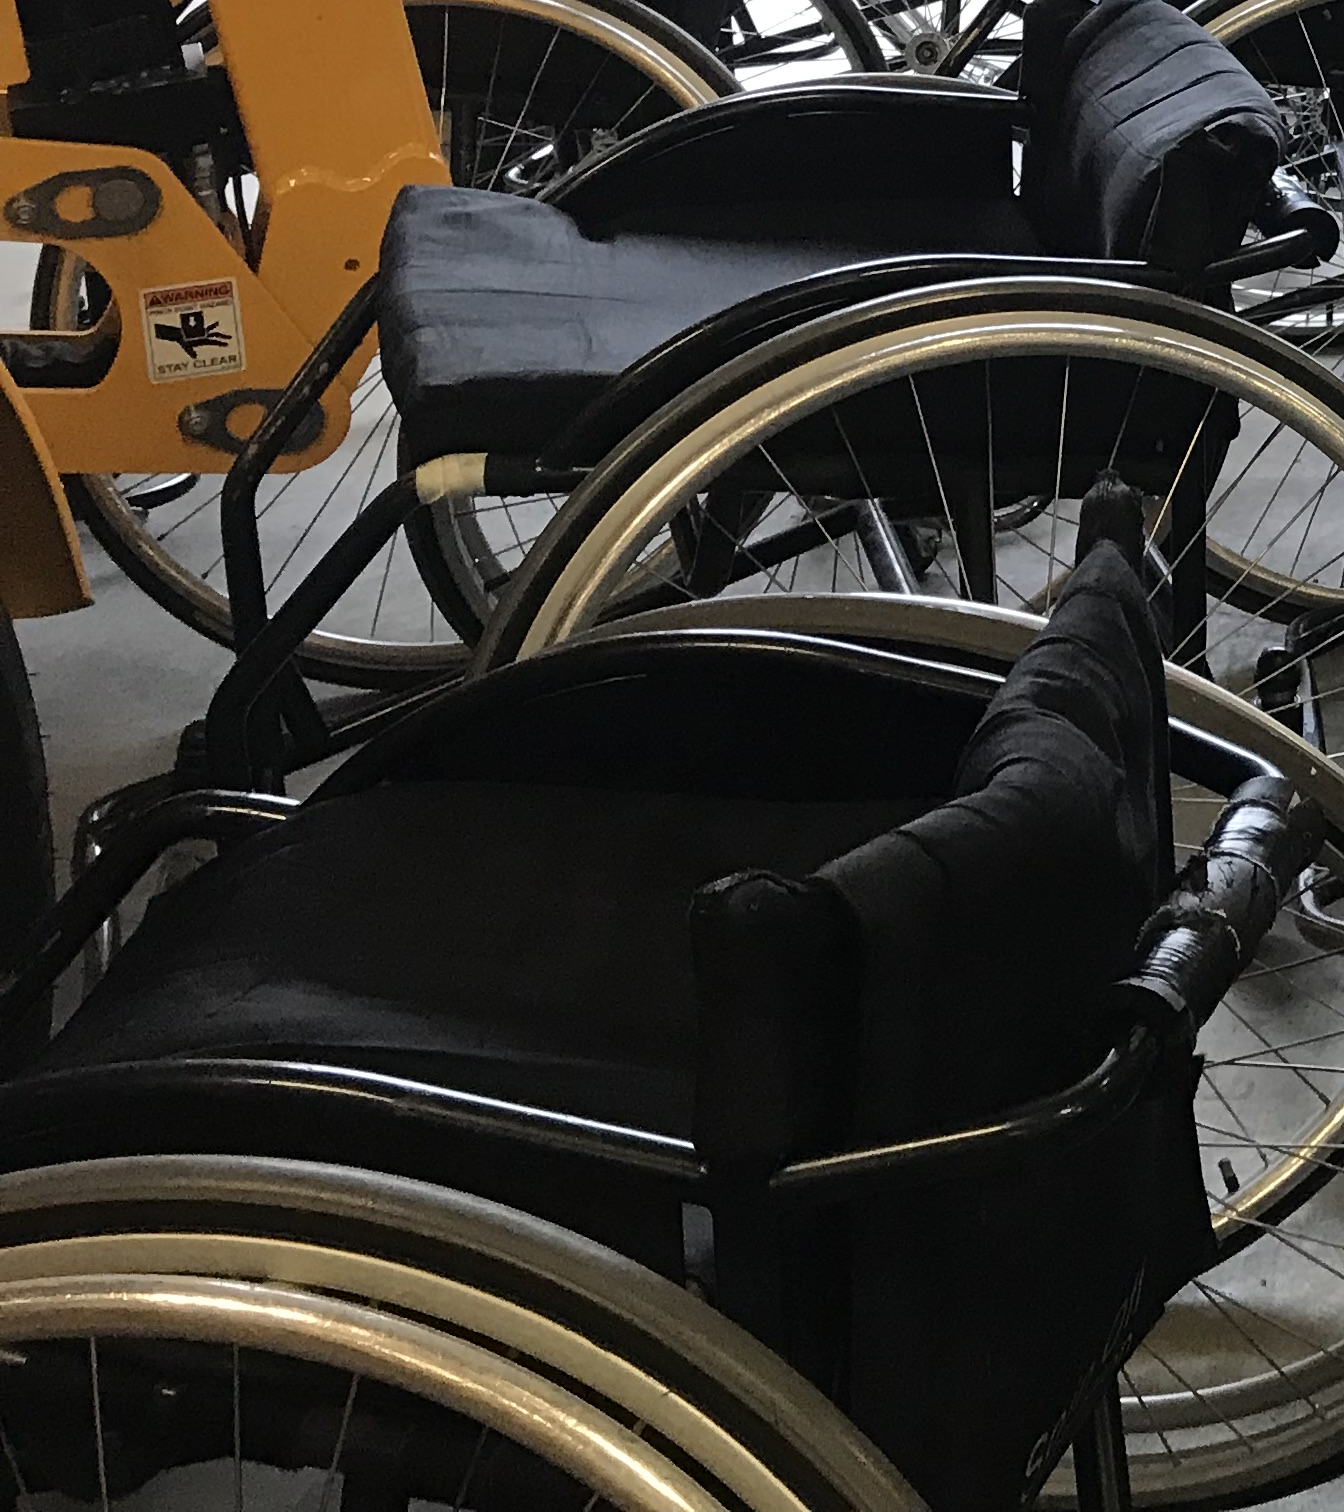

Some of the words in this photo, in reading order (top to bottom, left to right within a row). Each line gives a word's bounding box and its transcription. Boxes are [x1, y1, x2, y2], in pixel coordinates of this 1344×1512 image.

[162, 285, 230, 303] WARNING
[157, 362, 189, 374] STAY
[193, 354, 237, 368] CLEAR
